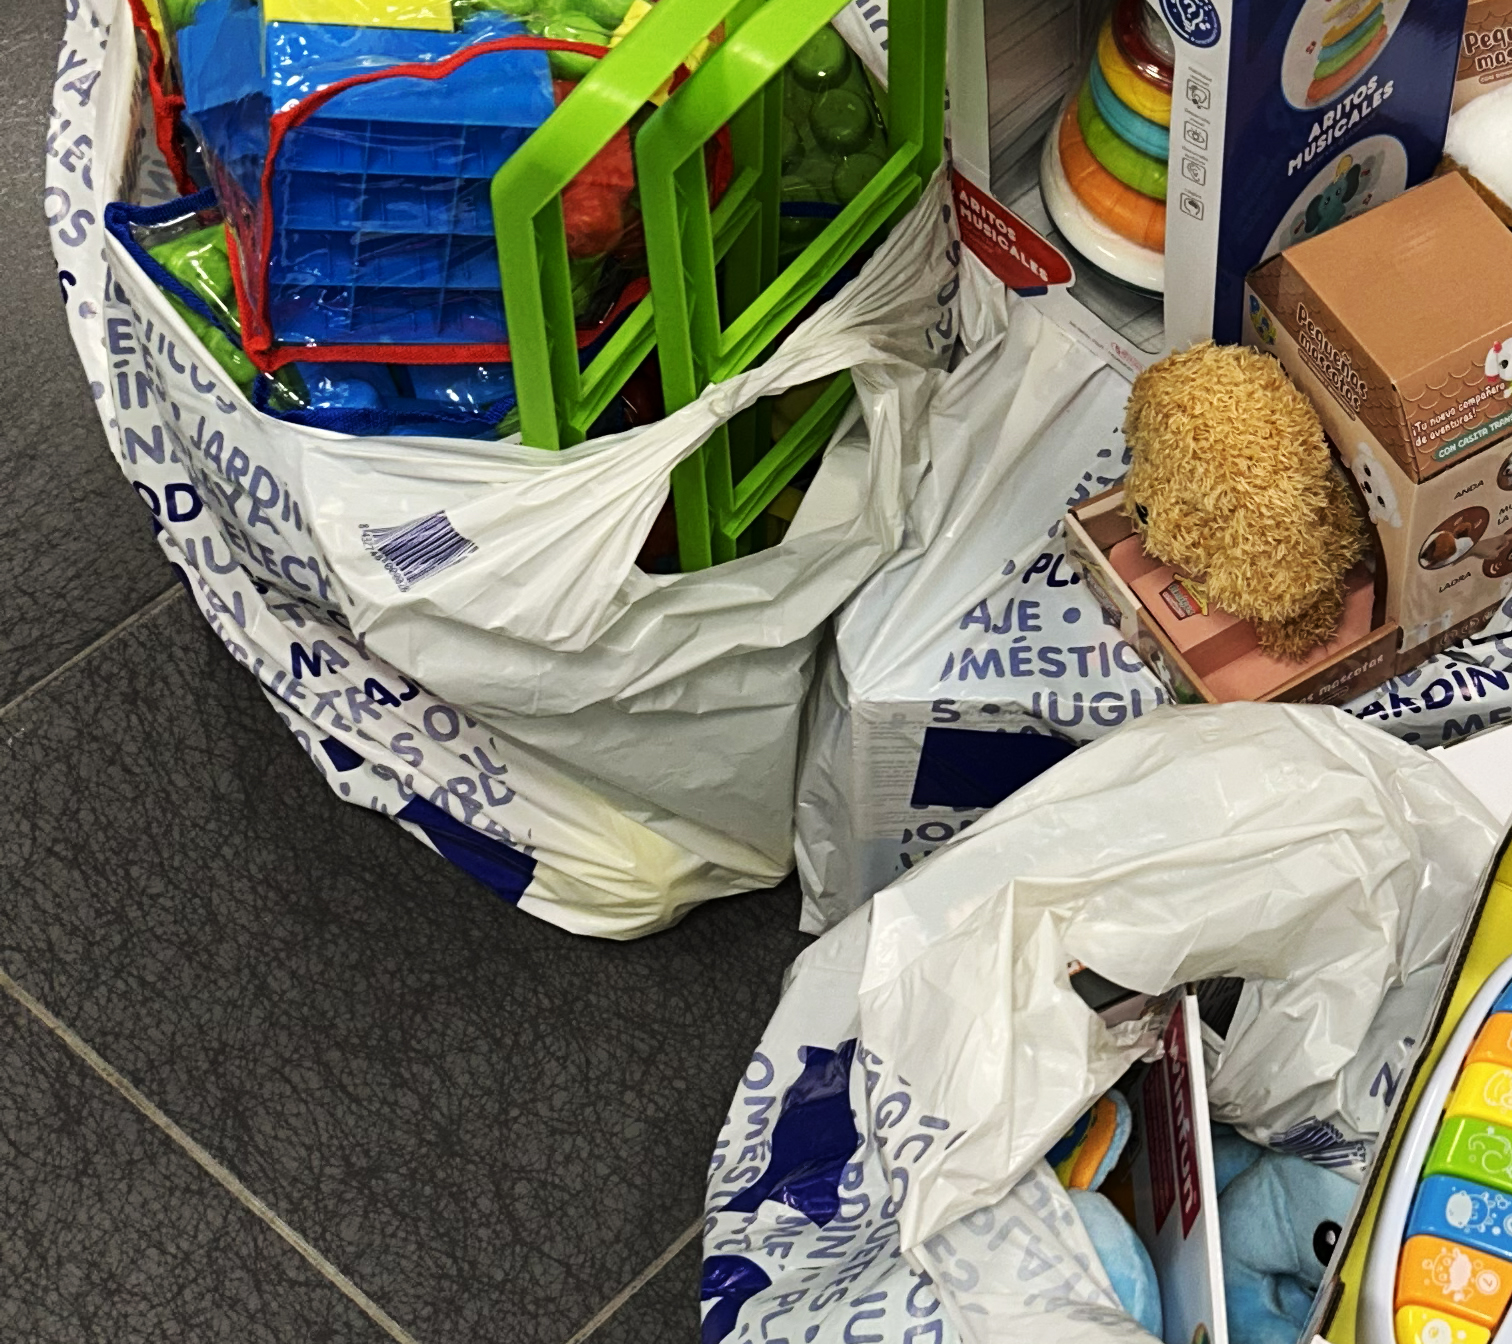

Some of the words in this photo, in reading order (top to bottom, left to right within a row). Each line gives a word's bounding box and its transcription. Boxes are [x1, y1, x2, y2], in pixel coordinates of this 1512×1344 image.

[1287, 80, 1395, 177] MUSICALES
[1307, 75, 1379, 142] ARITOS
[957, 190, 1016, 242] ARITOS
[958, 207, 1049, 281] MUSICALES
[1297, 302, 1368, 400] Pequeñas
[1298, 328, 1361, 412] mascotas
[1411, 421, 1428, 438] ¡Tu
[1430, 408, 1457, 428] nuevo
[1458, 382, 1506, 415] compañero
[1415, 433, 1429, 447] de
[1429, 407, 1478, 441] aventuras!
[1438, 444, 1457, 459] CON
[1457, 426, 1488, 449] CASITA
[1454, 479, 1485, 500] ANDA
[1497, 512, 1510, 526] LA
[1439, 571, 1471, 594] LADRA
